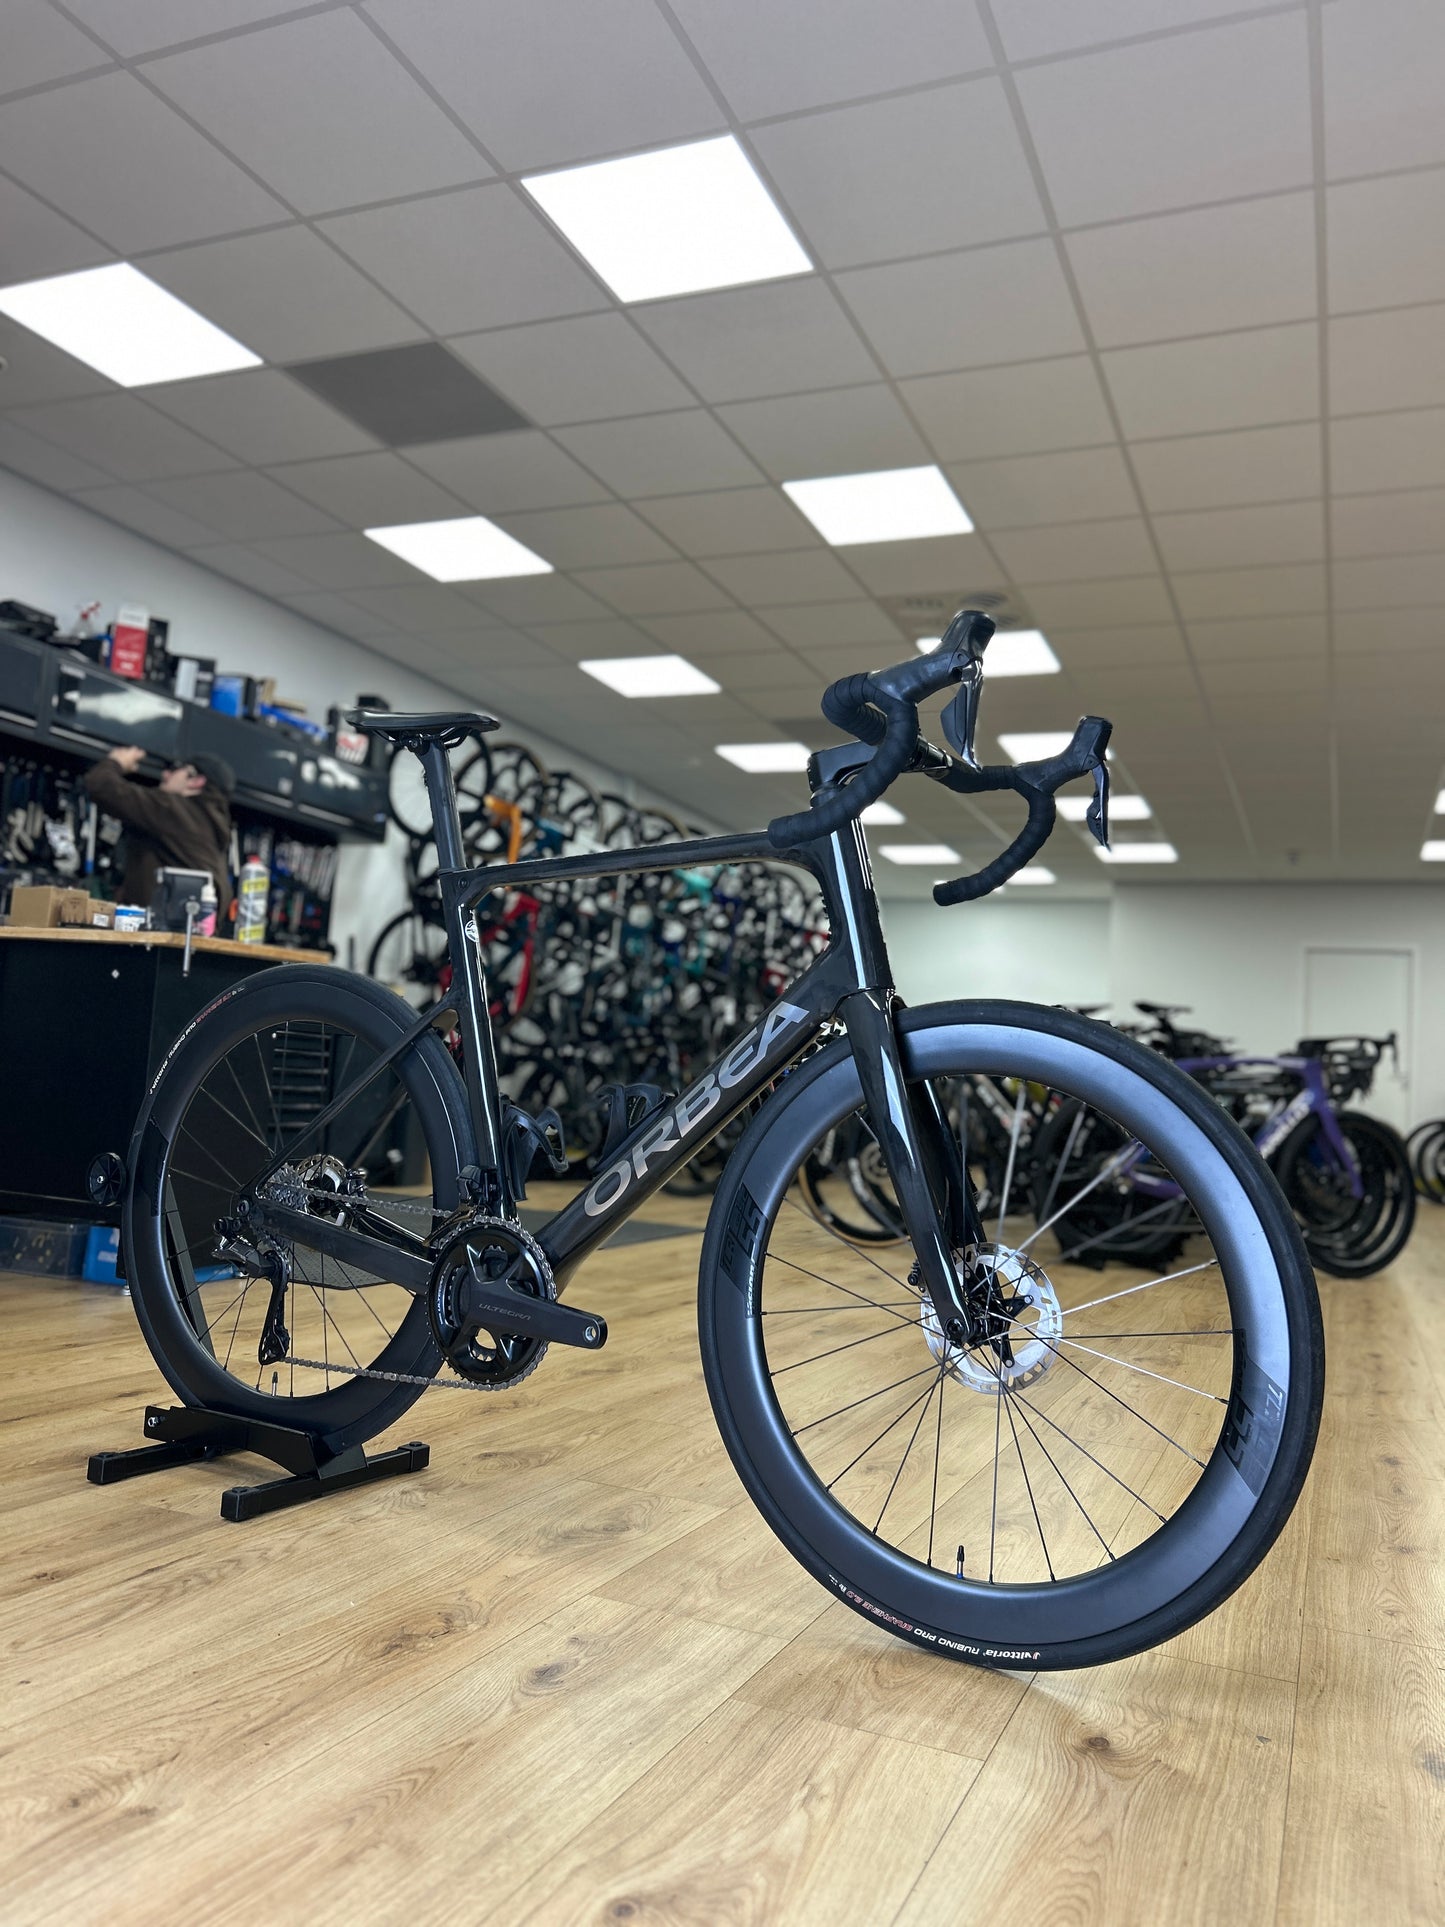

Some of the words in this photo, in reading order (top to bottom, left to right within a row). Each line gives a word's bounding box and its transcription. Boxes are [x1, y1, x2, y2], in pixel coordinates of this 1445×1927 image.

[584, 1002, 810, 1217] ORBEA
[914, 1627, 938, 1642] PRO
[938, 1637, 980, 1655] RUBINO
